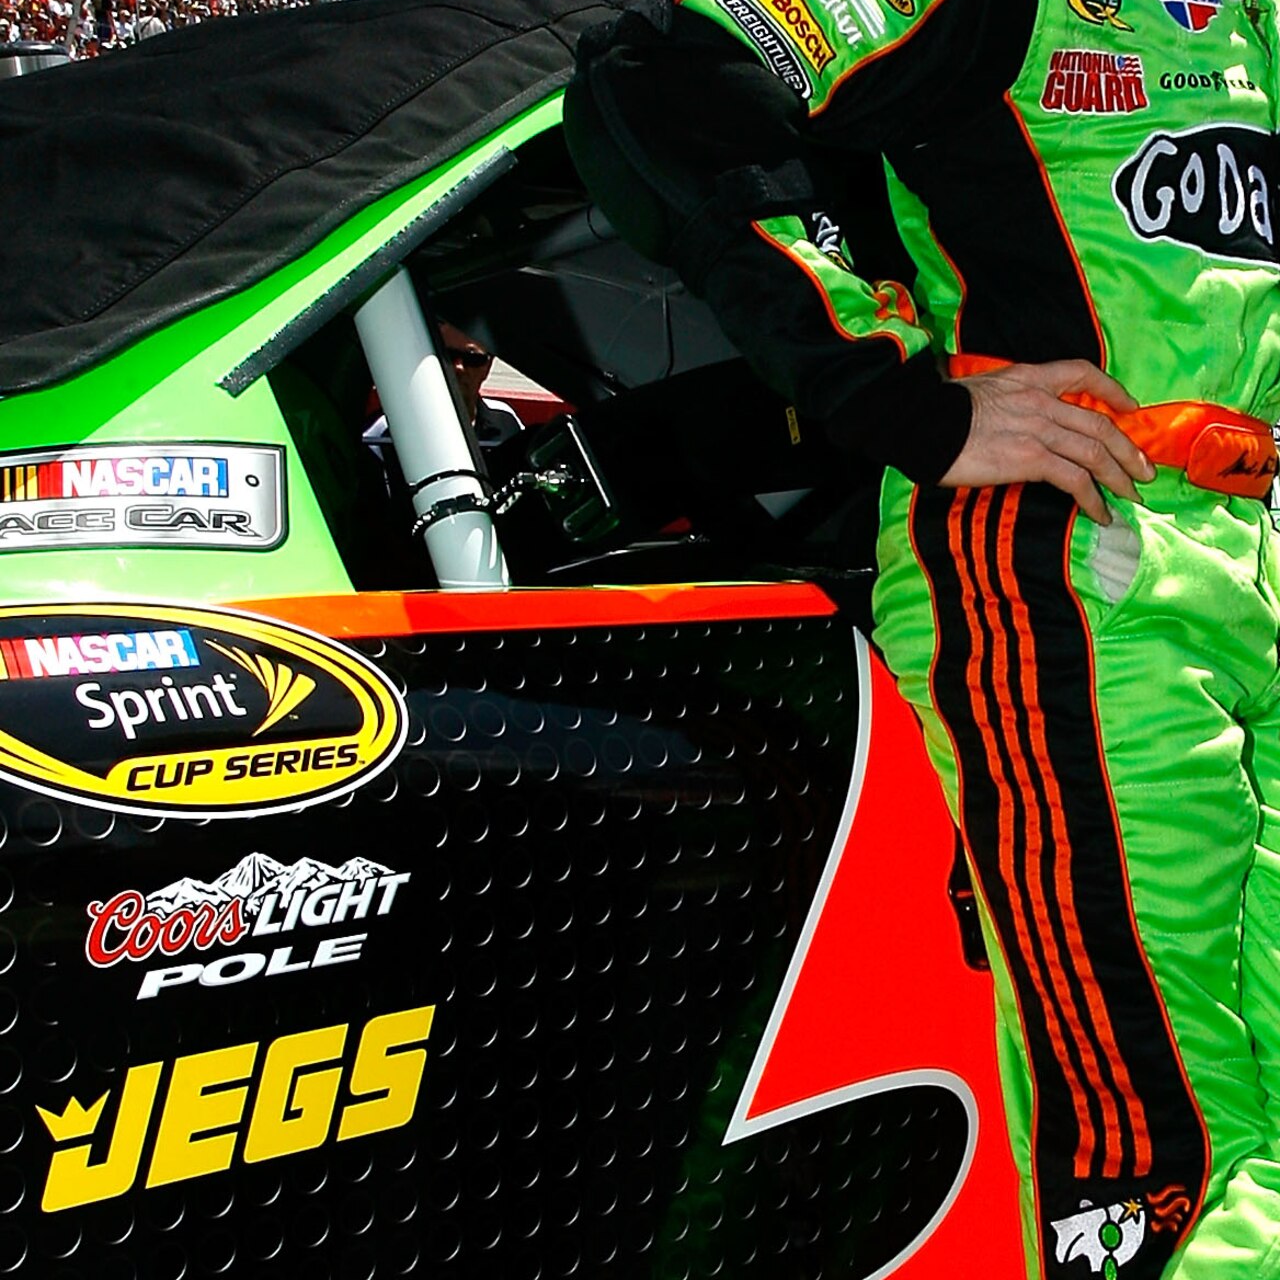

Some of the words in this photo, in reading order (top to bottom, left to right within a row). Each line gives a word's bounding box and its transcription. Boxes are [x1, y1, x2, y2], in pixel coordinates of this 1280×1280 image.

[1050, 50, 1118, 74] NATIONAL
[1041, 70, 1149, 113] GUARD
[61, 457, 228, 498] NASCAR
[0, 508, 116, 538] ACE
[124, 505, 263, 538] CAR
[25, 630, 199, 678] NASCAR
[75, 672, 248, 739] Sprint
[126, 758, 214, 793] CUP
[223, 743, 359, 782] SERIES
[85, 889, 249, 969] Coors
[251, 872, 412, 938] LIGHT
[136, 932, 368, 1001] POLE
[41, 1004, 437, 1213] JEGS
